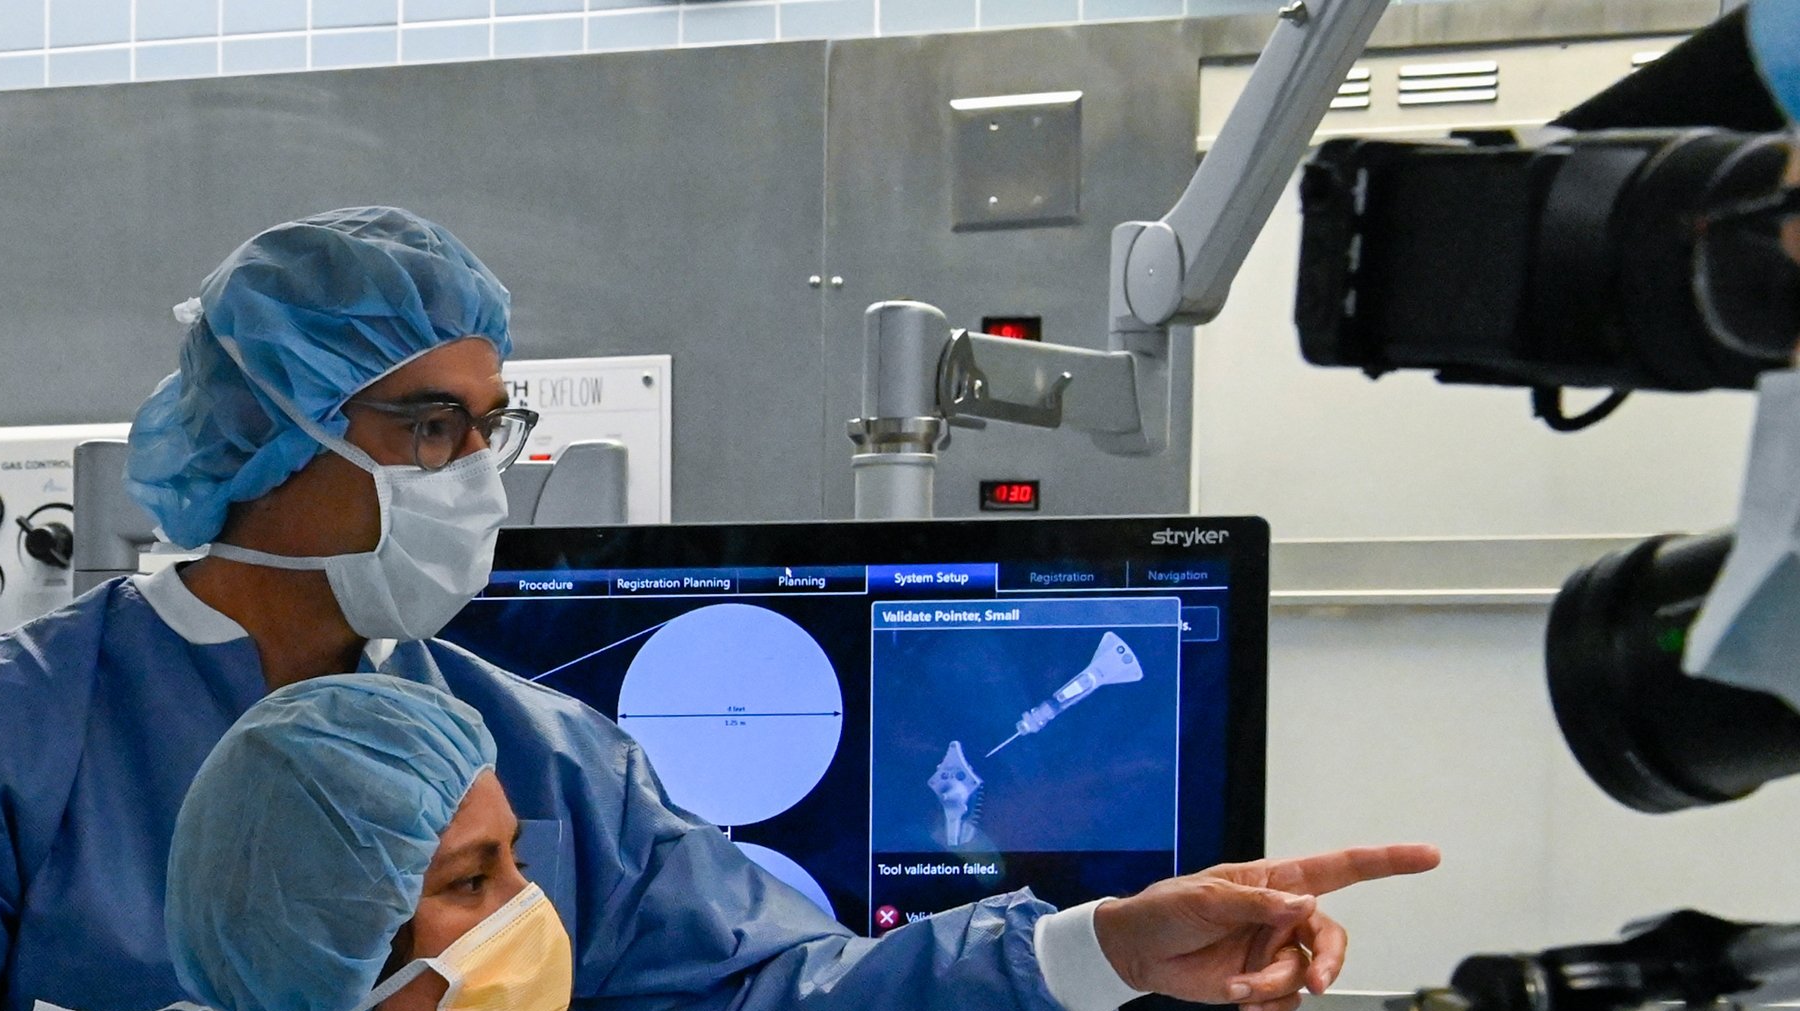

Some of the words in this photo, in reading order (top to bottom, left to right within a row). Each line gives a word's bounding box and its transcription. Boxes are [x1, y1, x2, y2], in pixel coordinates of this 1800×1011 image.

[1, 462, 22, 471] GAS
[1151, 527, 1229, 547] stryker
[778, 576, 826, 589] Planning
[894, 572, 933, 586] System
[936, 572, 969, 585] Setup
[1030, 571, 1094, 585] Registration
[1148, 570, 1208, 582] Navigation
[519, 580, 573, 591] Procedure
[617, 578, 680, 591] Registration
[684, 577, 731, 590] Planning
[882, 611, 932, 623] Validate
[935, 610, 982, 622] Pointer,
[985, 609, 1020, 621] Small
[878, 864, 901, 874] Tool
[905, 863, 960, 875] validation
[963, 863, 998, 874] failed.
